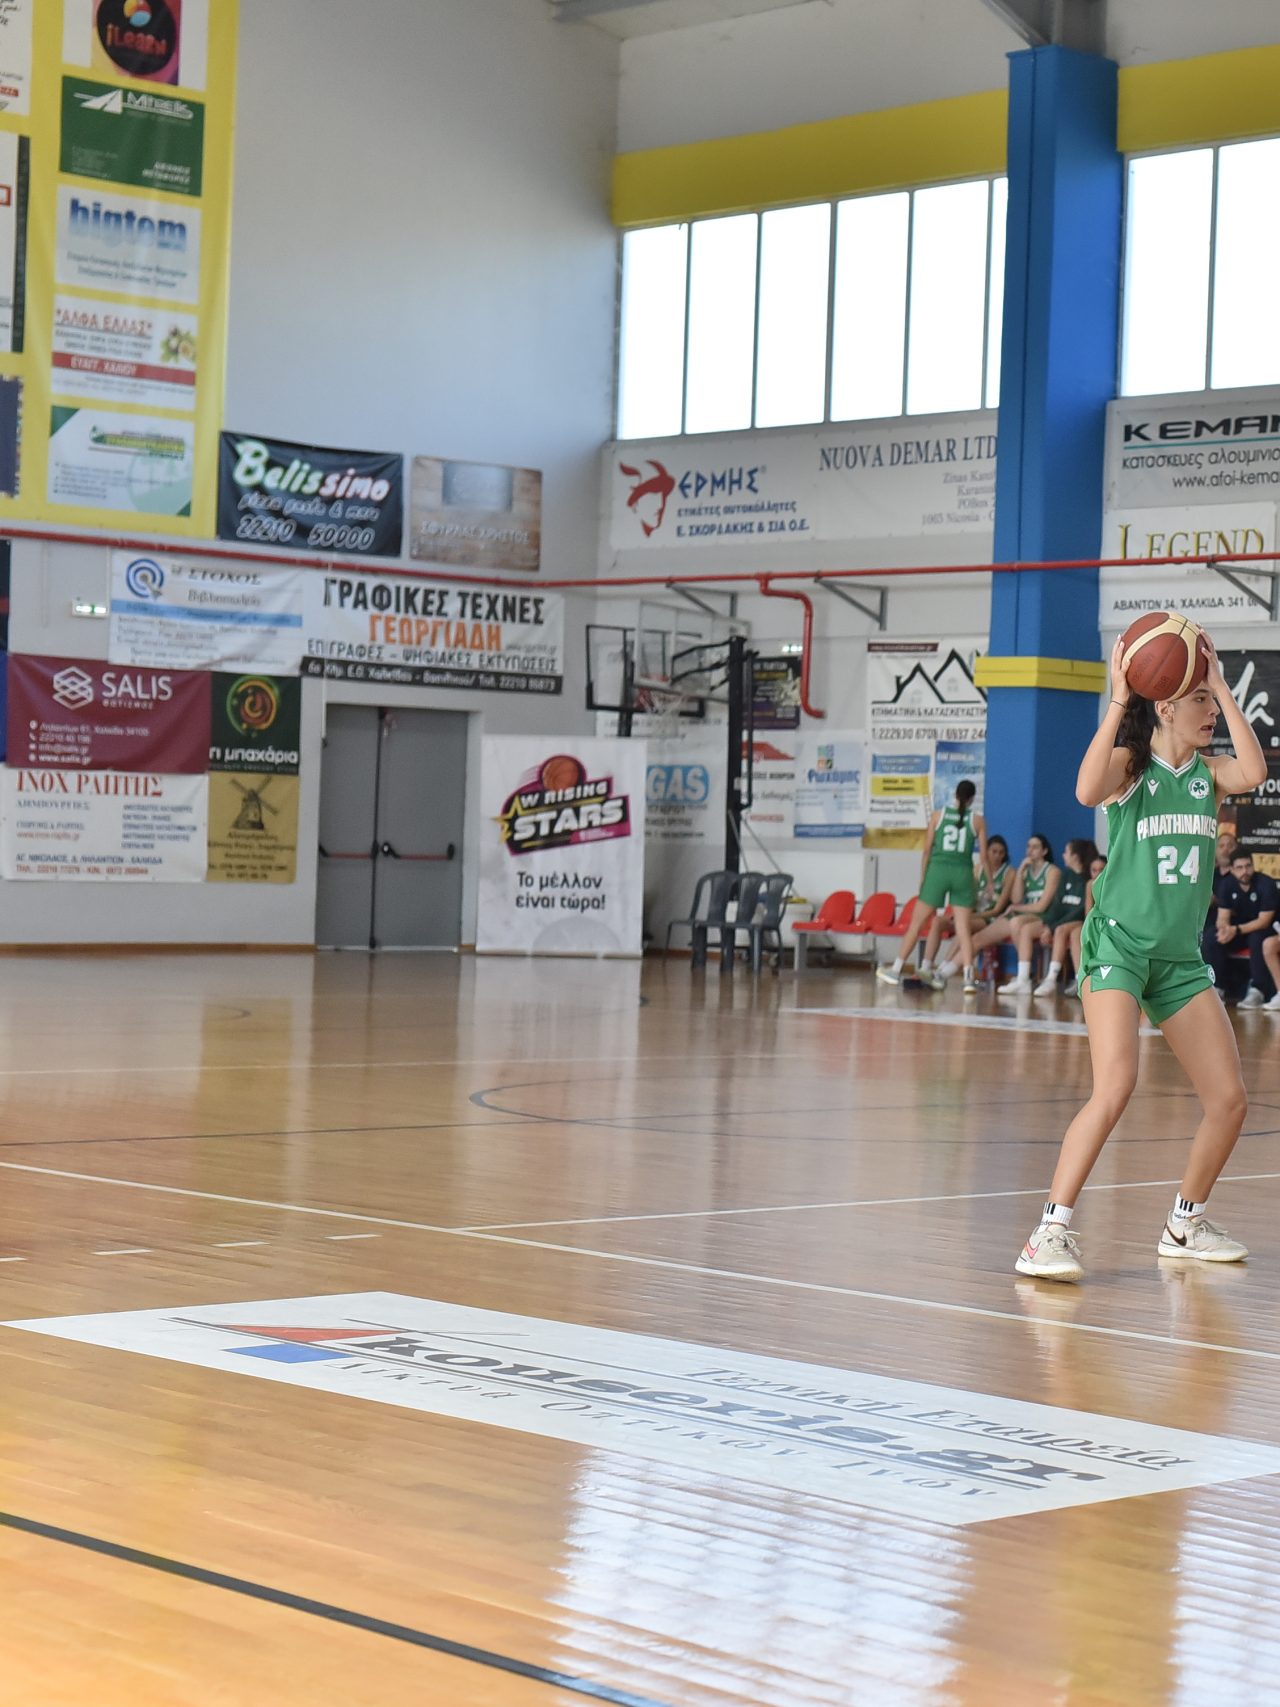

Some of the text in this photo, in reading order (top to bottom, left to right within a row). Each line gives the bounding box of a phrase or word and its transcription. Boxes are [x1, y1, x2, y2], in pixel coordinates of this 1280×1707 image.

[819, 444, 884, 471] NUOVA
[889, 438, 957, 466] DEMAR
[679, 467, 758, 498] ΕΡΜΗΣ
[307, 523, 376, 550] 50000
[324, 577, 448, 617] ΓΡΑΦΙΚΕΣ
[457, 590, 544, 625] ΤΕΧΝΕΣ
[1113, 599, 1162, 611] ΑΒΑΝΤΩΝ
[1181, 597, 1225, 610] ΧΑΛΚΙΔΑ
[369, 613, 503, 652] ΓΕΩΡΓΙΑΔΗ
[403, 648, 471, 665] ΨΗΦΙΑΚΕΣ
[479, 653, 557, 672] ΕΚΤΥΠΩΣΕΙΣ
[102, 672, 173, 701] SALIS
[521, 781, 608, 808] W RISING
[513, 799, 623, 841] STARS
[942, 827, 967, 853] 21
[1158, 846, 1199, 884] 24
[517, 872, 603, 890] Το μέλλον
[515, 894, 606, 914] είναι τώρα!
[684, 1366, 1198, 1470] Τεχνική Εταιρεία
